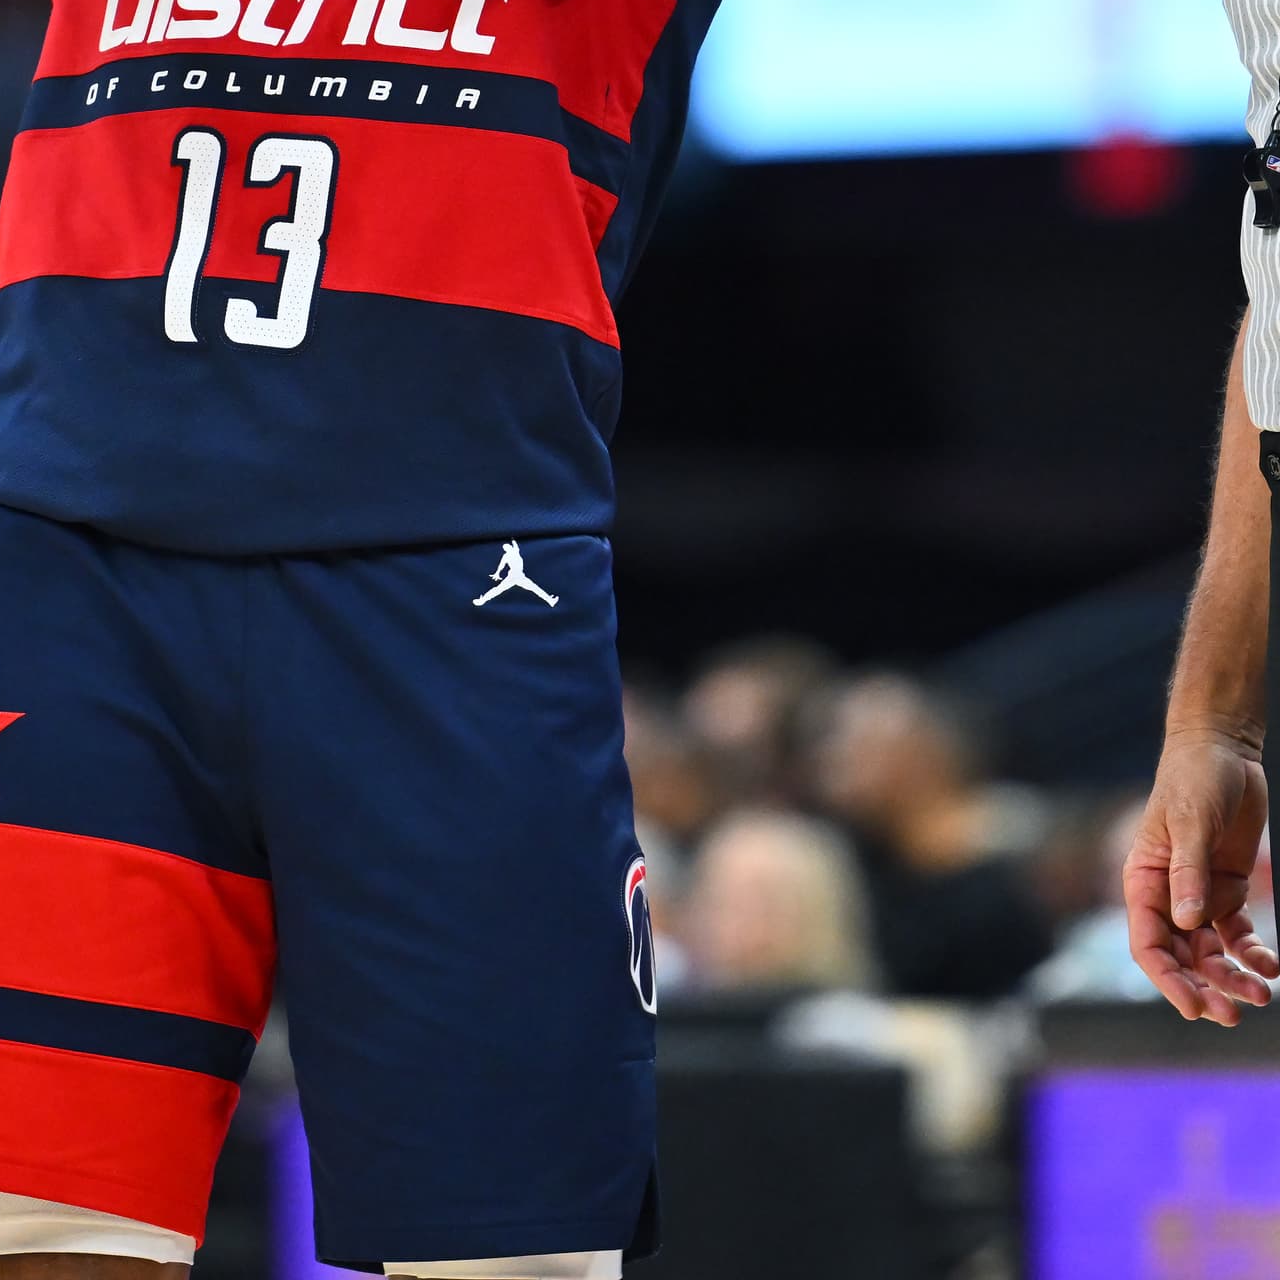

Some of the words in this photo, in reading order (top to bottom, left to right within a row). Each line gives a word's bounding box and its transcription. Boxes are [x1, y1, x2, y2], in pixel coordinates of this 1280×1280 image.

[86, 77, 121, 105] OF
[150, 70, 481, 110] COLUMBIA
[163, 130, 335, 350] 13
